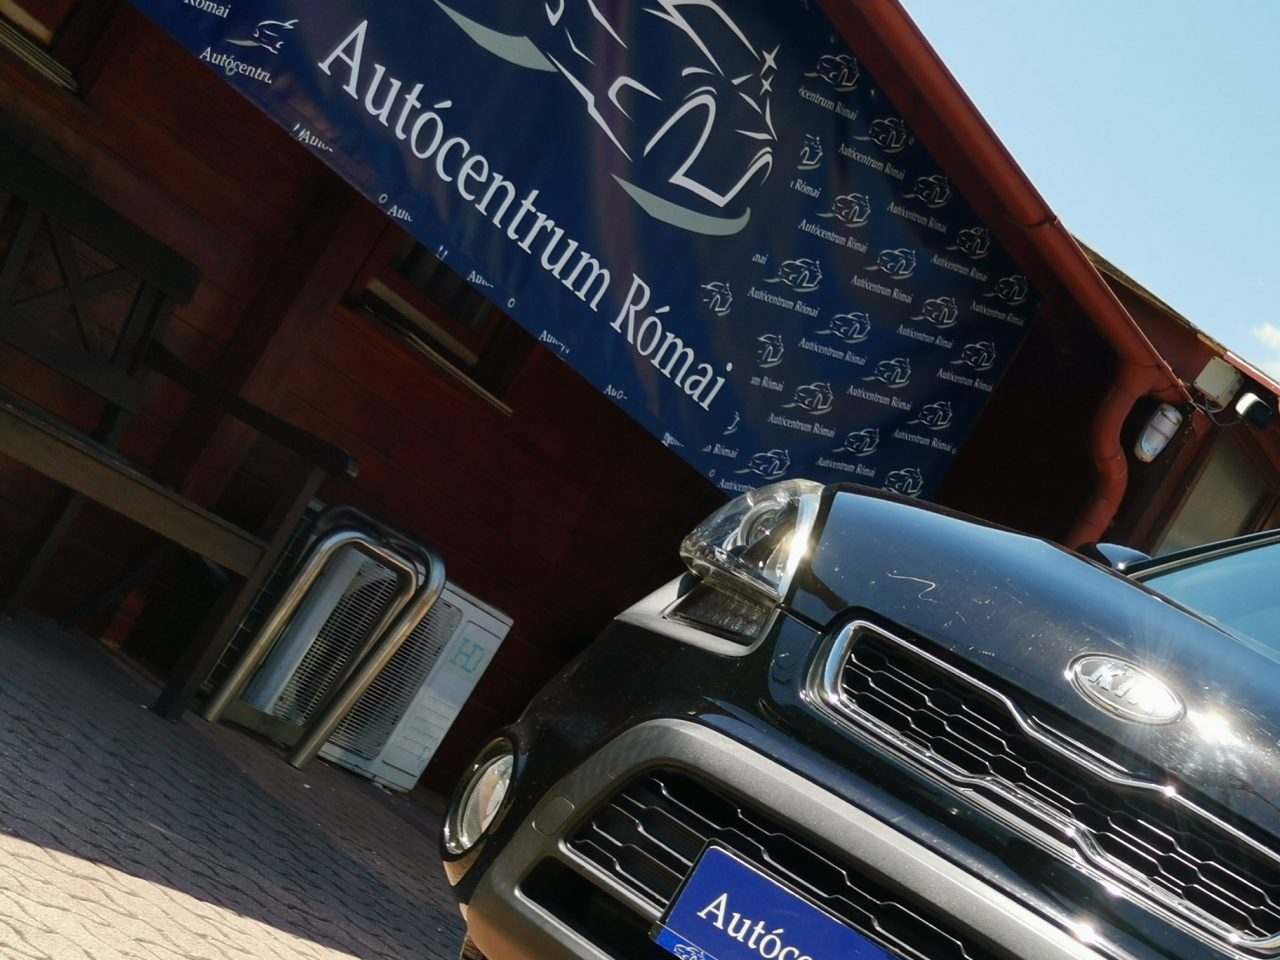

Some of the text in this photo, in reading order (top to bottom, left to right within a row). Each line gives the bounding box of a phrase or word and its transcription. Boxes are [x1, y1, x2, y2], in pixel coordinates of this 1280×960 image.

[317, 19, 733, 411] Autócentrum Római
[795, 179, 821, 198] Római
